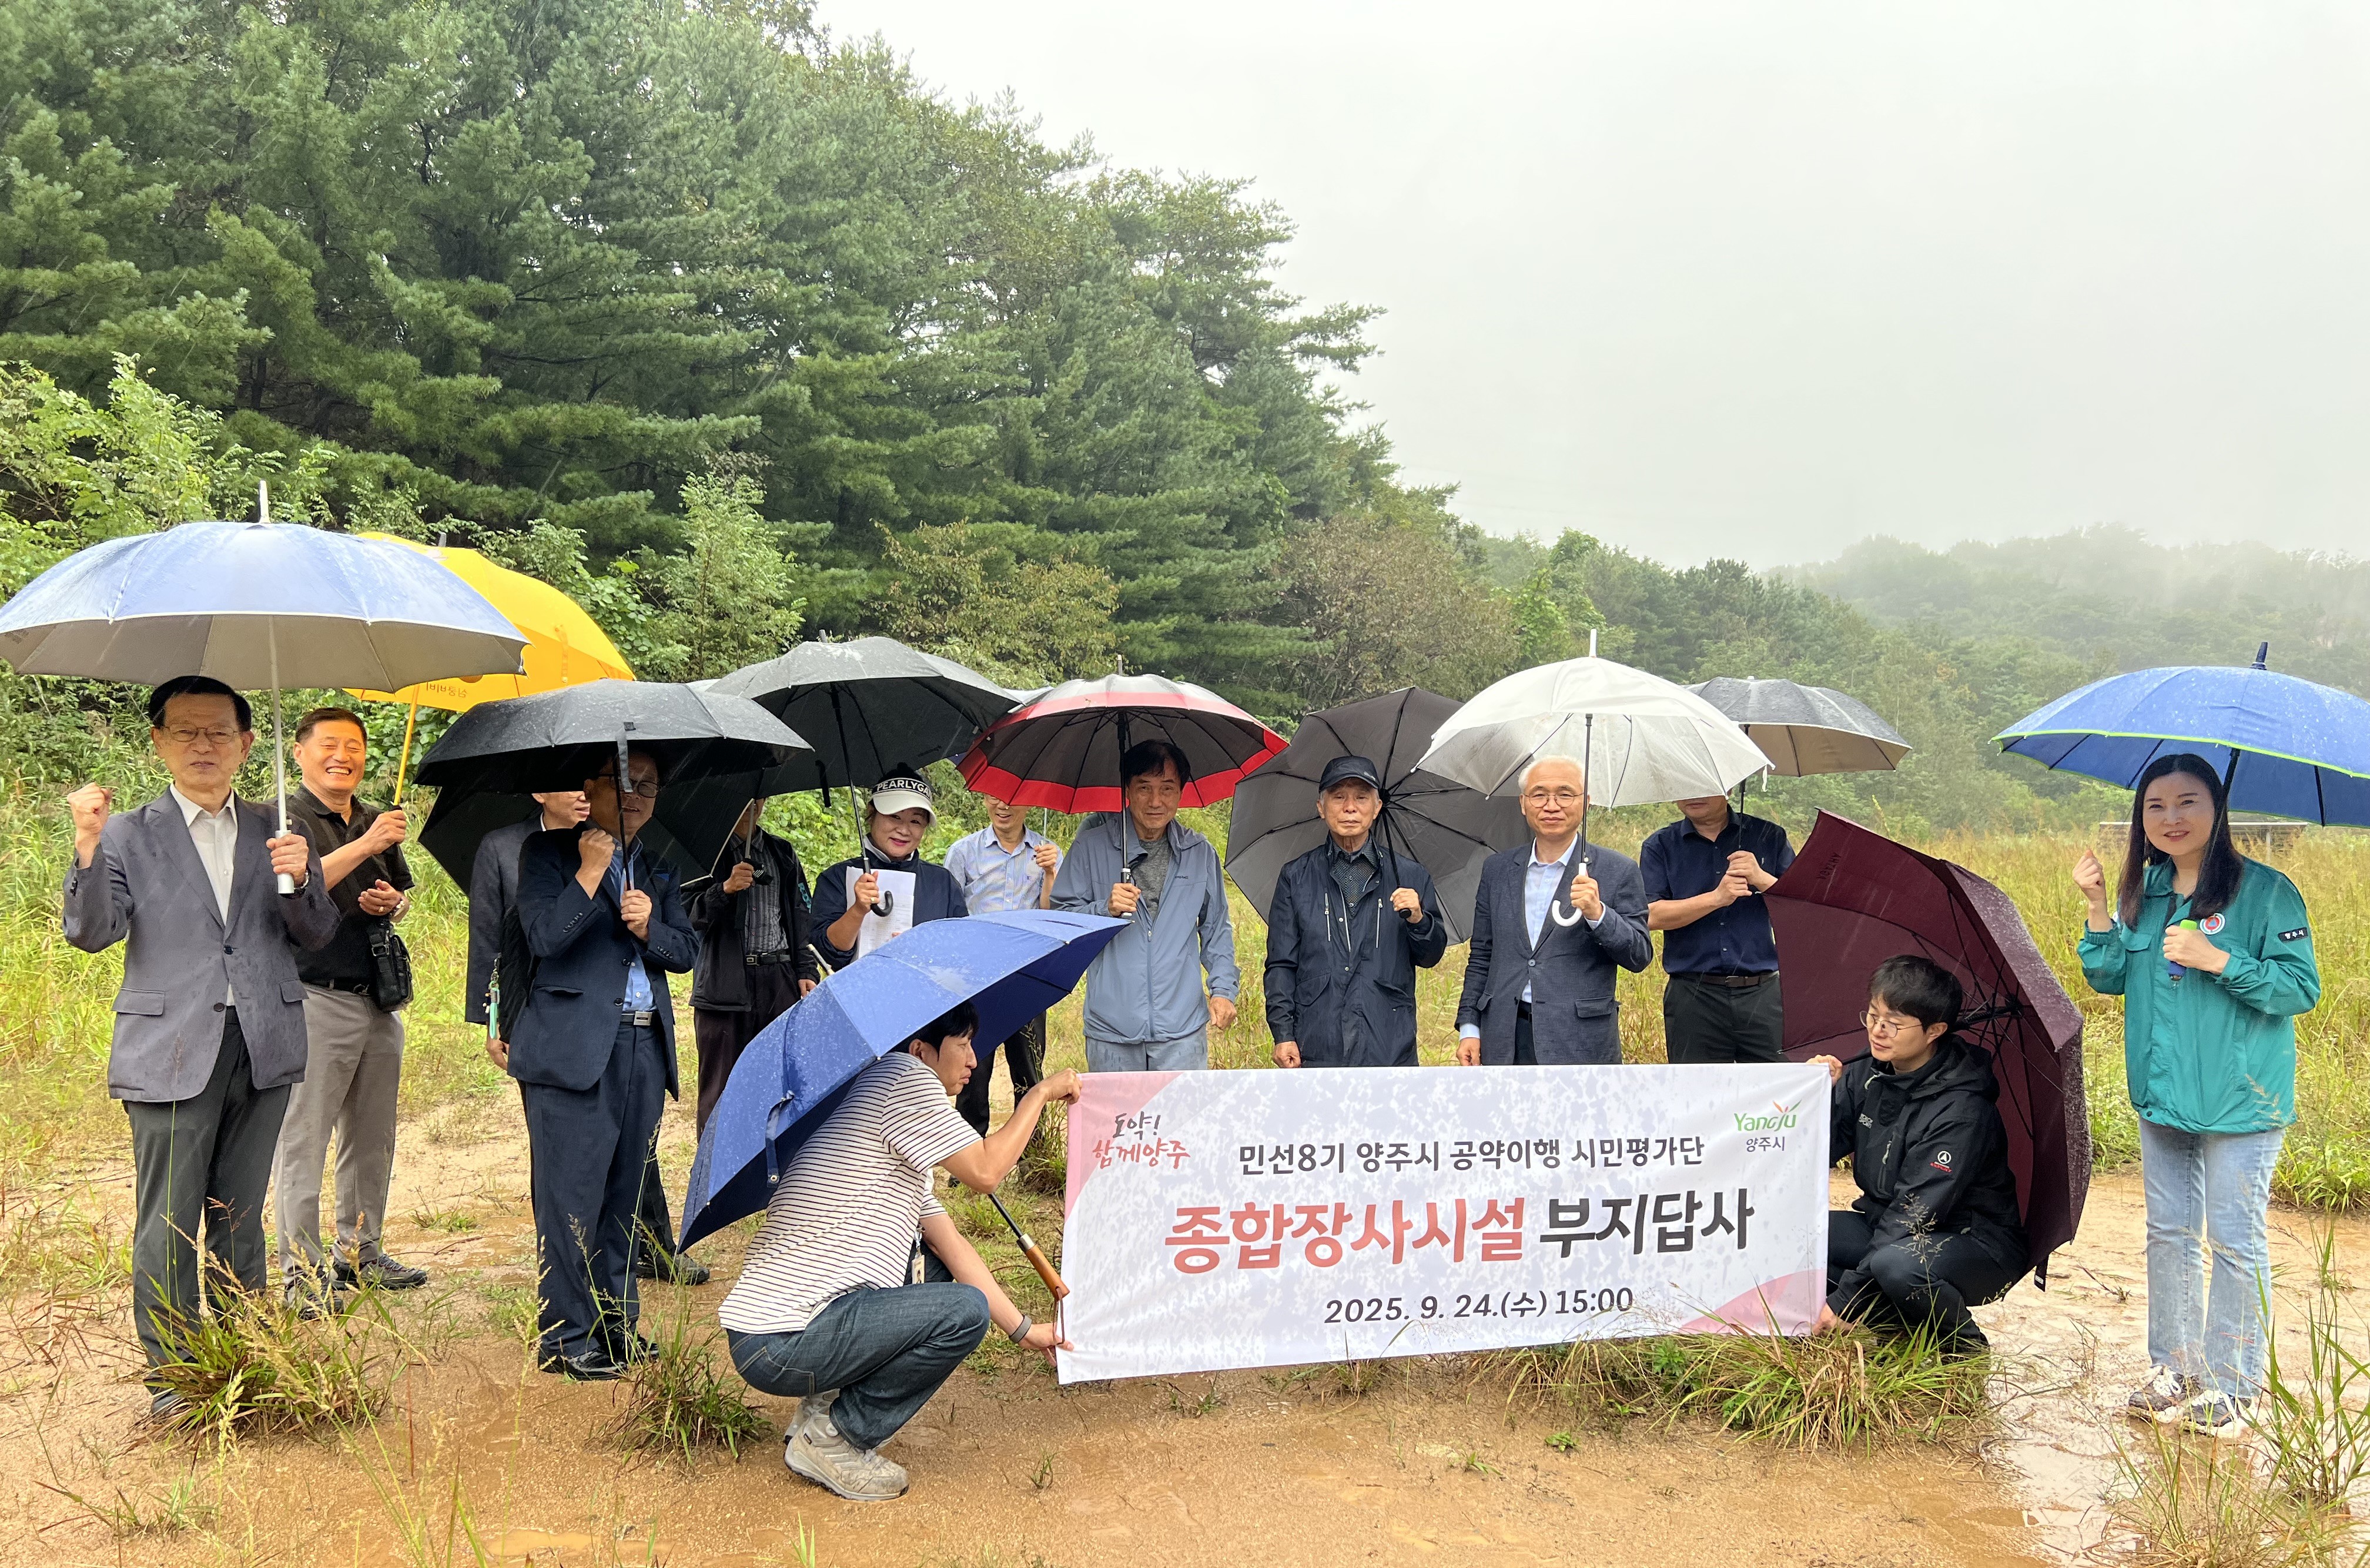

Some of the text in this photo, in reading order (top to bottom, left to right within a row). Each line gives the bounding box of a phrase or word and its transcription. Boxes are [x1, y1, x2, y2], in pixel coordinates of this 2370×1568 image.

[1112, 1111, 1161, 1141] 도약!
[1092, 1137, 1191, 1169] 함께양주
[1240, 1136, 1705, 1175] 민선8기 양주시 공약이행 시민평가단
[1746, 1136, 1785, 1152] 양주시
[1165, 1188, 1755, 1274] 종합장사시설 부지답사
[1324, 1286, 1633, 1324] 2025. 9. 24.(수) 15:00
